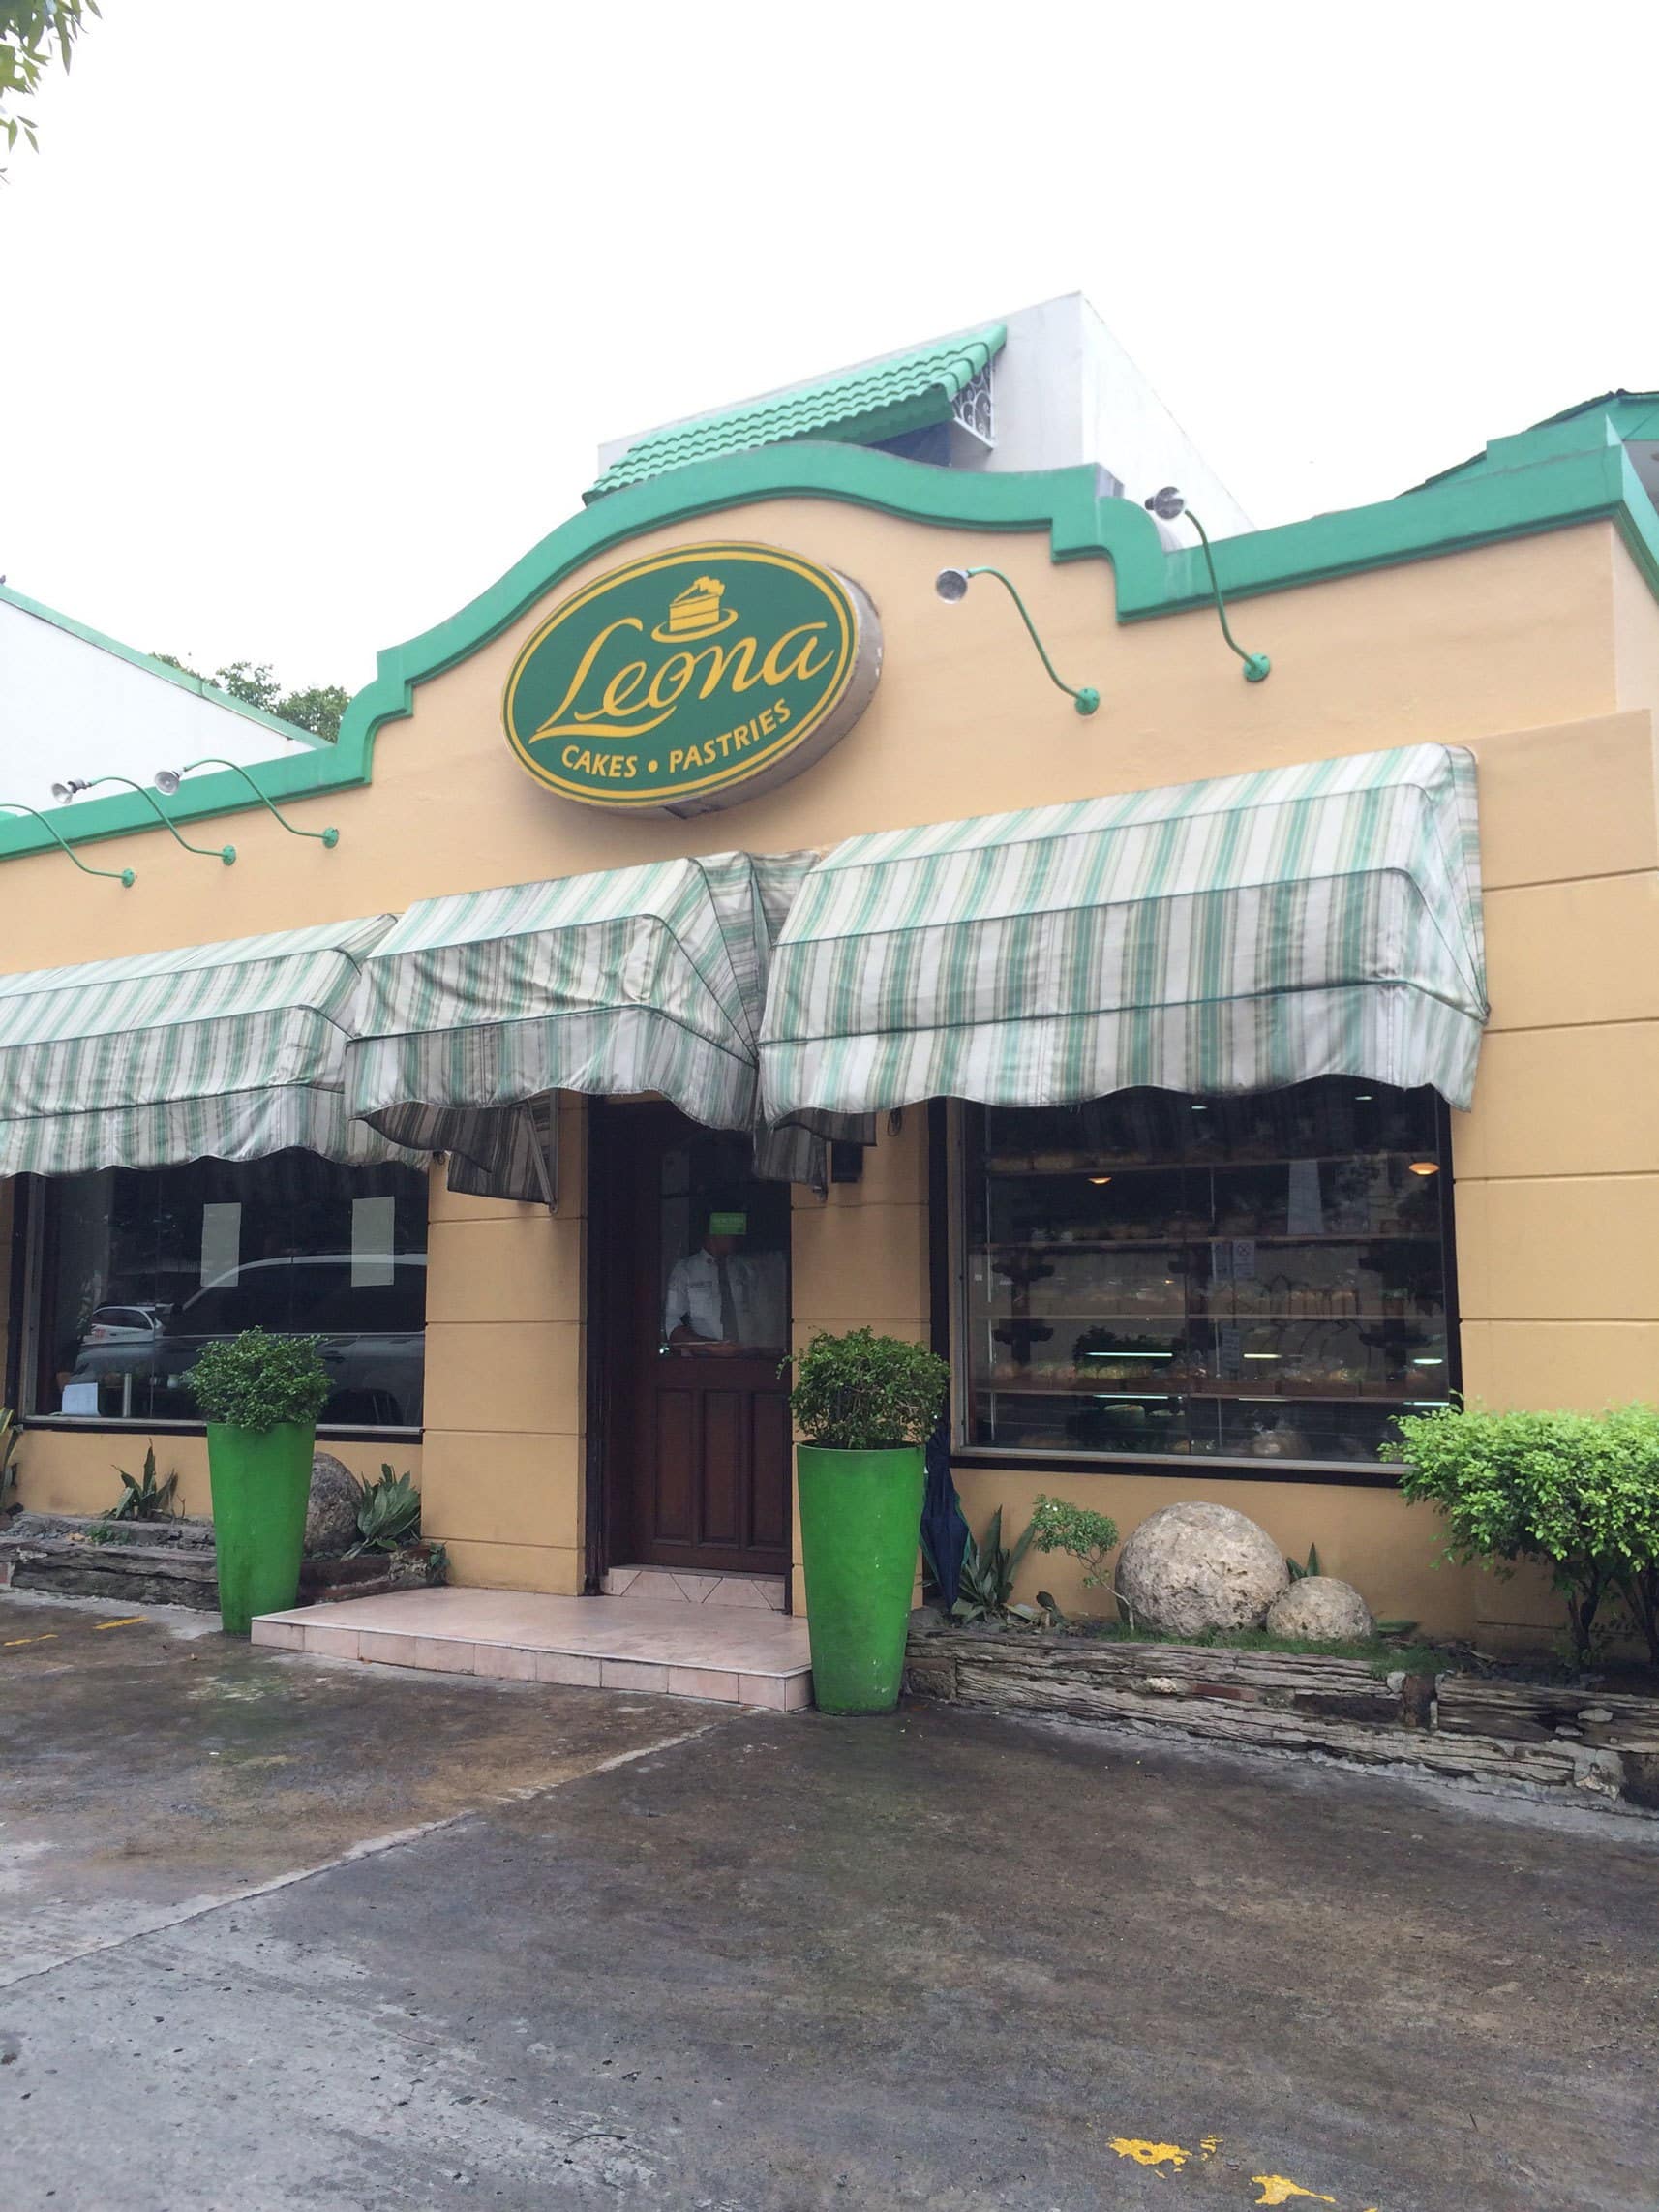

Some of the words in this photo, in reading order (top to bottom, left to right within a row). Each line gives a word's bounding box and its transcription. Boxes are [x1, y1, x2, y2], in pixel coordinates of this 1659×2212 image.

[528, 618, 834, 744] Leona
[561, 744, 638, 778] CAKES
[669, 698, 792, 773] PASTRIES
